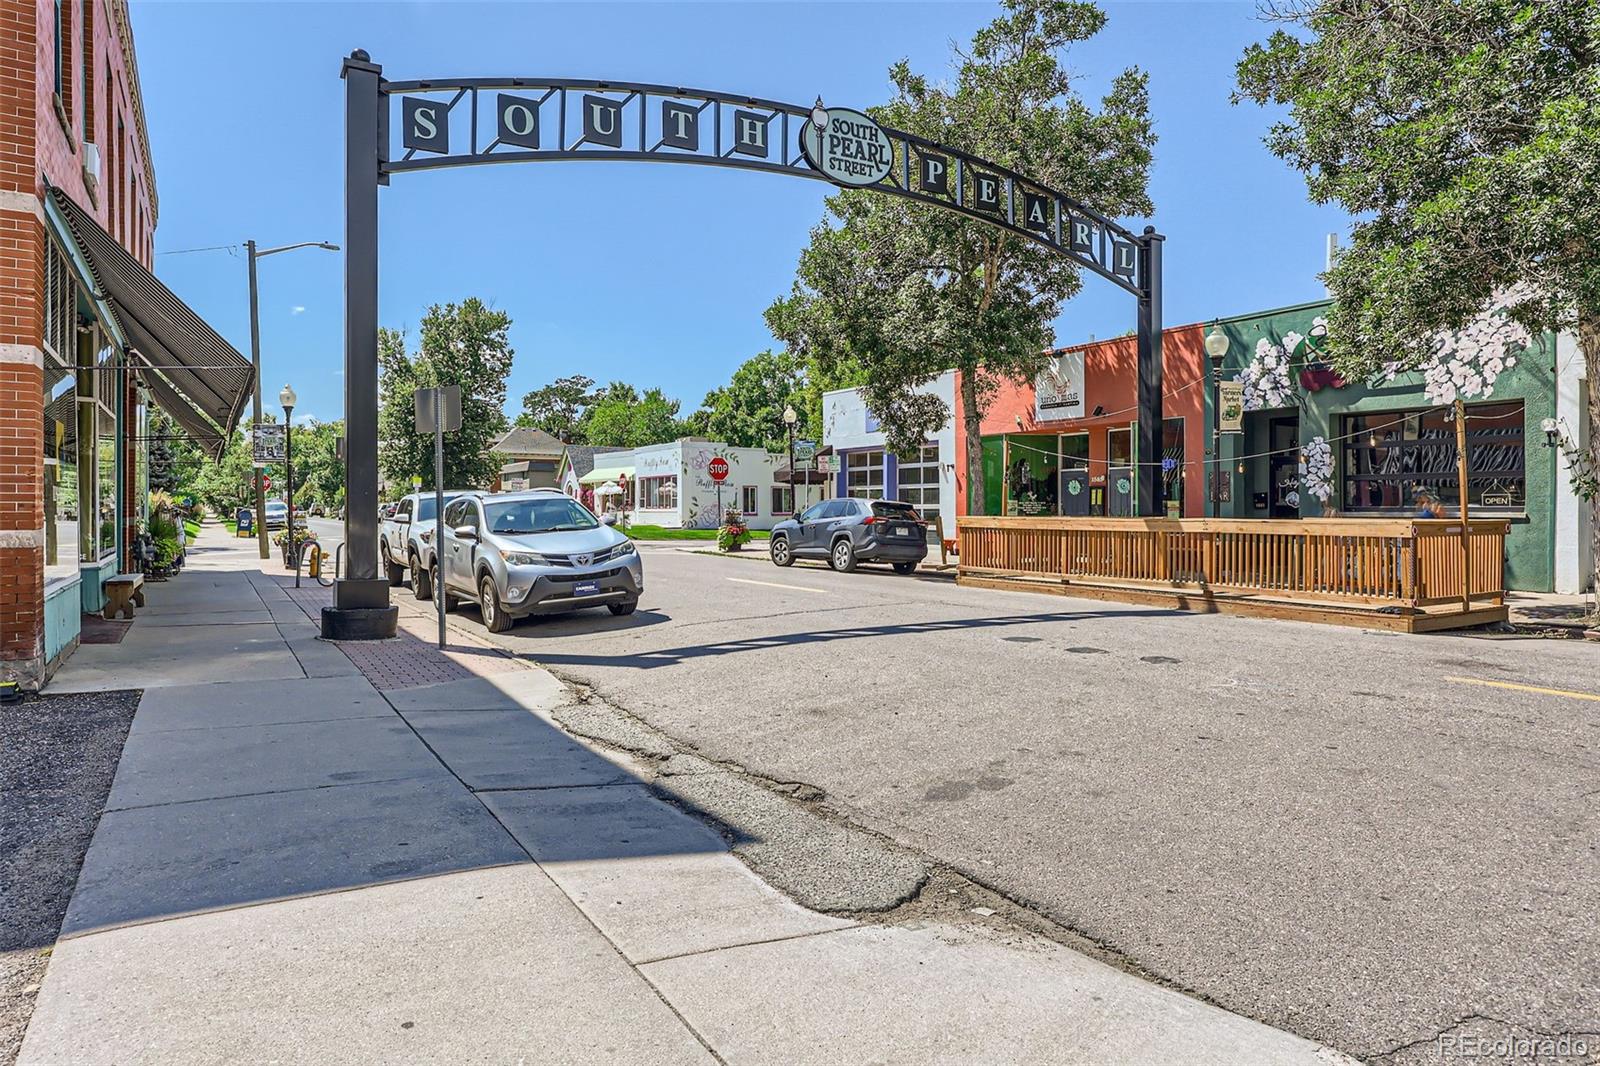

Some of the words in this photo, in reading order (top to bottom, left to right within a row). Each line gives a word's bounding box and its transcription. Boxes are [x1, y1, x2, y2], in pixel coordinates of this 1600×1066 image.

[832, 118, 879, 143] SOUTH
[829, 134, 889, 172] PEARL
[829, 157, 874, 177] STREET
[414, 104, 765, 147] SOUTH
[926, 160, 1134, 269] PEARL
[709, 464, 728, 474] STOP
[1484, 497, 1508, 505] OPEN
